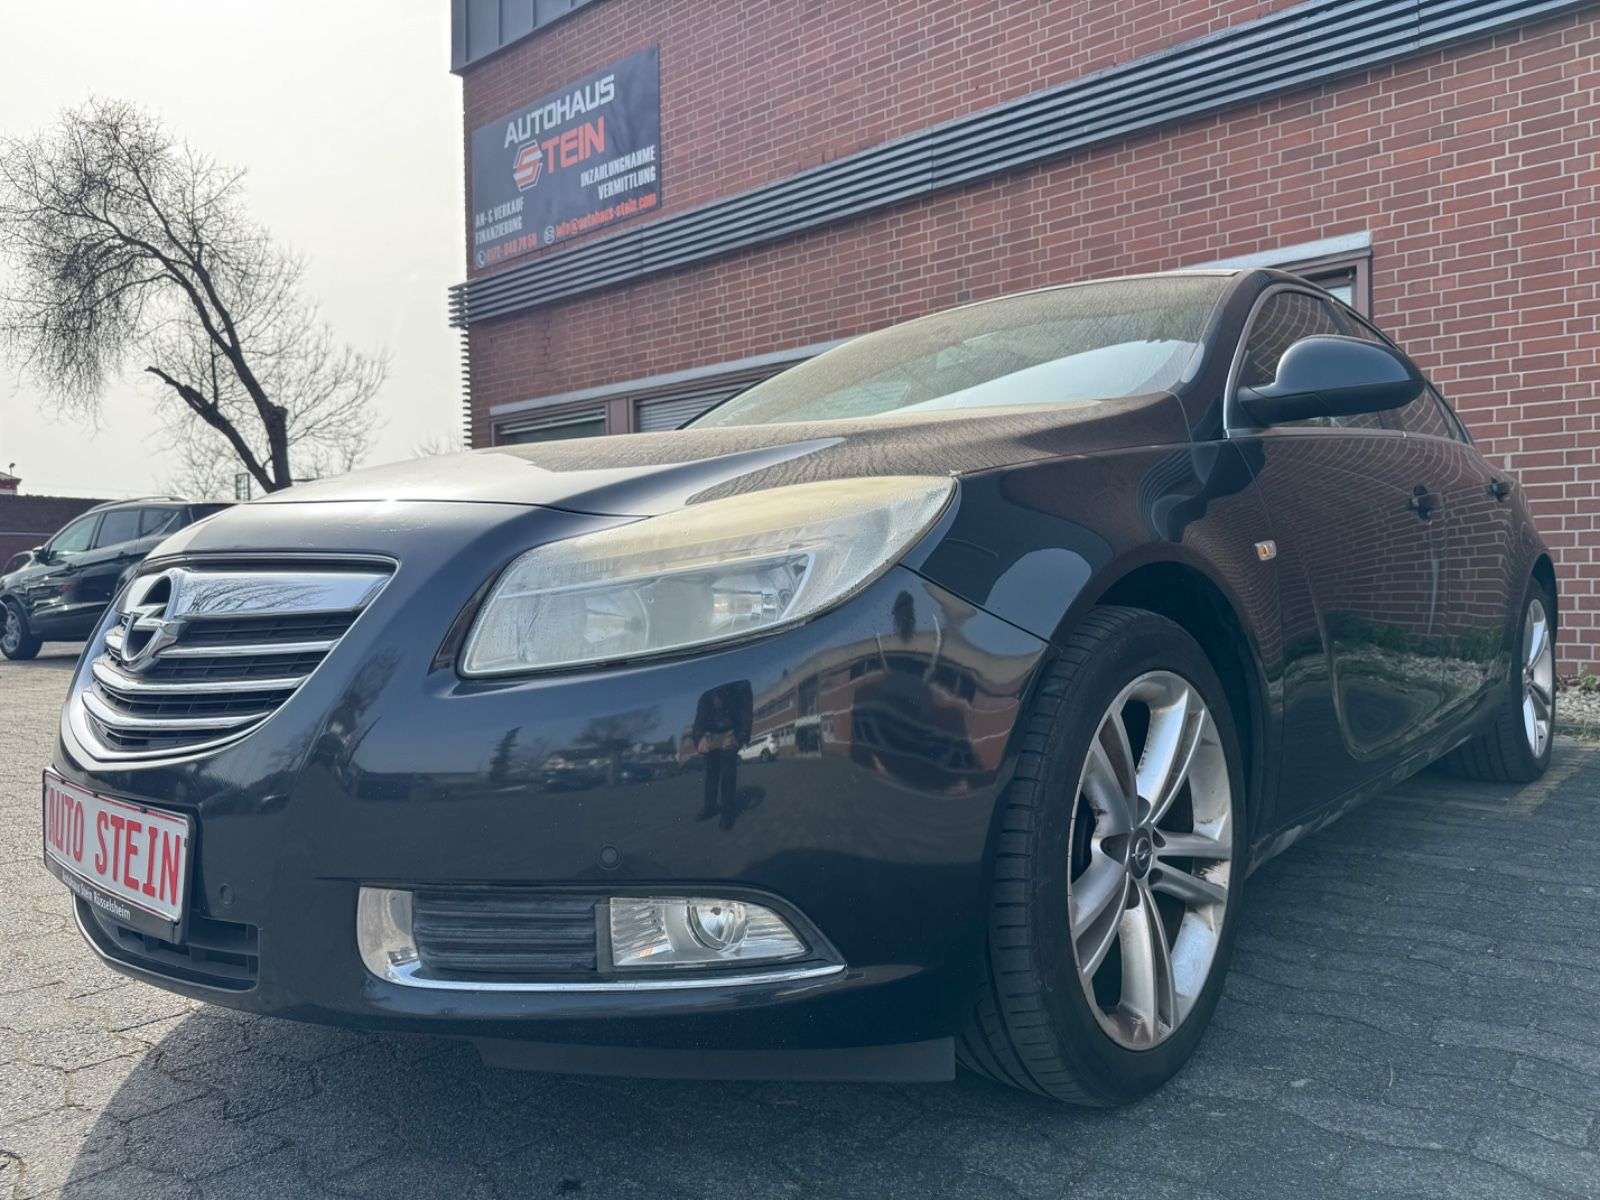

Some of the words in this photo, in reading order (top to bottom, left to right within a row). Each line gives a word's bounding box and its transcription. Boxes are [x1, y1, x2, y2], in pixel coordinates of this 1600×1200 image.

[504, 74, 615, 148] AUTOHAUS
[513, 115, 605, 192] STEIN
[598, 165, 656, 200] VERMITTLUNG
[49, 787, 84, 863] AUTO
[95, 810, 181, 906] STEIN
